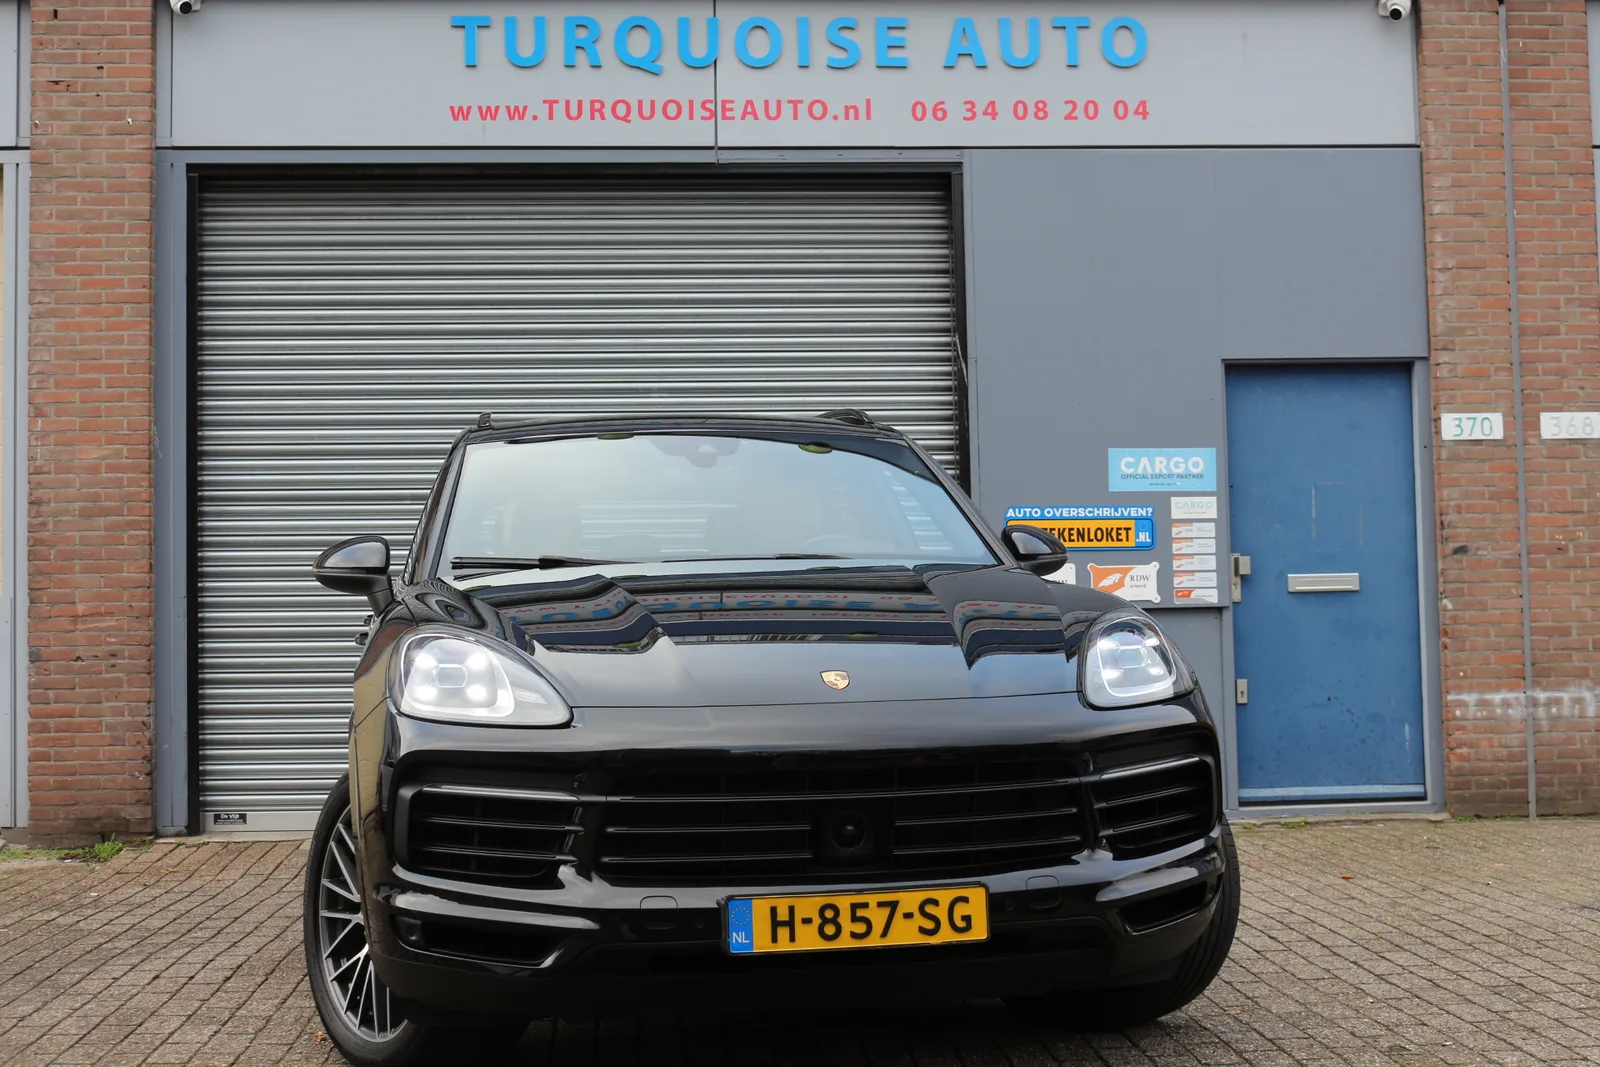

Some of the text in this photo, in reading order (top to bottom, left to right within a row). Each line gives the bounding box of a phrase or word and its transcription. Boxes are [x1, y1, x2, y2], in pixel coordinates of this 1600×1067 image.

[451, 15, 1149, 75] TURQUOISE AUTO
[449, 98, 1150, 124] www.TURQUOISEAUTO.nl 06 34 08 20 04
[1452, 416, 1493, 438] 370
[1550, 416, 1594, 437] 368
[1120, 456, 1205, 474] CARGO
[1007, 507, 1153, 517] AUTO OVERSCHRIJVEN?
[1130, 574, 1151, 582] RDW
[769, 895, 973, 944] H-857-SG
[731, 931, 750, 943] NL
